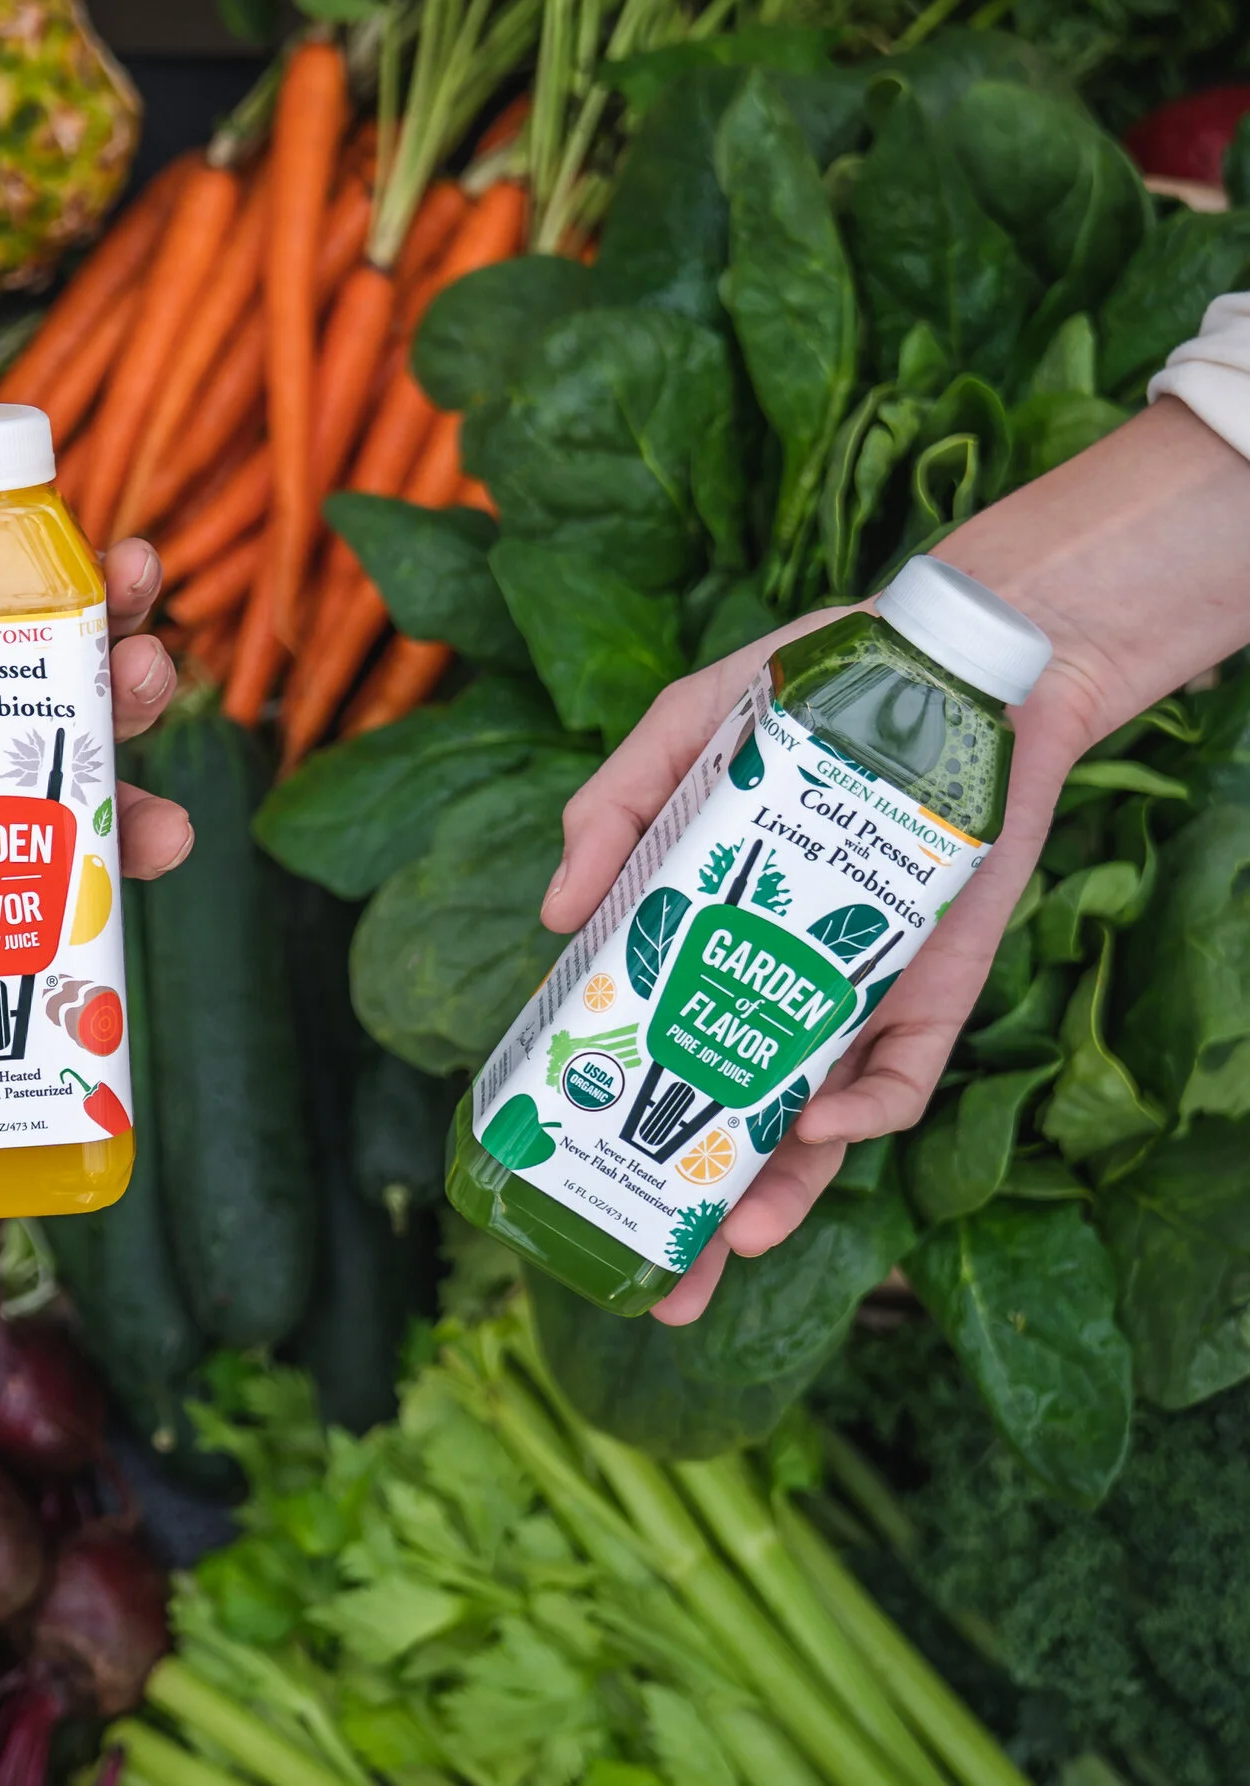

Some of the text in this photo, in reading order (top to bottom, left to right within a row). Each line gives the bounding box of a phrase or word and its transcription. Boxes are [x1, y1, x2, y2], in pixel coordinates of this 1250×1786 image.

[816, 760, 961, 857] GREEN HARMONY
[800, 789, 936, 886] Cold Pressed
[844, 838, 870, 860] with
[751, 806, 825, 861] Living
[826, 846, 925, 929] Probiotics
[4, 932, 40, 950] JUICE
[702, 929, 835, 1031] GARDEN
[679, 991, 779, 1070] FLAVOR
[735, 998, 765, 1018] of
[583, 1062, 615, 1089] USDA
[666, 1024, 754, 1088] PURE JOY JUICE
[5, 1084, 73, 1100] Pasteurized
[570, 1074, 609, 1103] ORGANIC
[30, 1121, 48, 1131] ML
[559, 1136, 677, 1217] Never Flash Pasteurized
[594, 1138, 667, 1191] Never Heated
[564, 1179, 638, 1232] 16 FL OZ/473 ML
